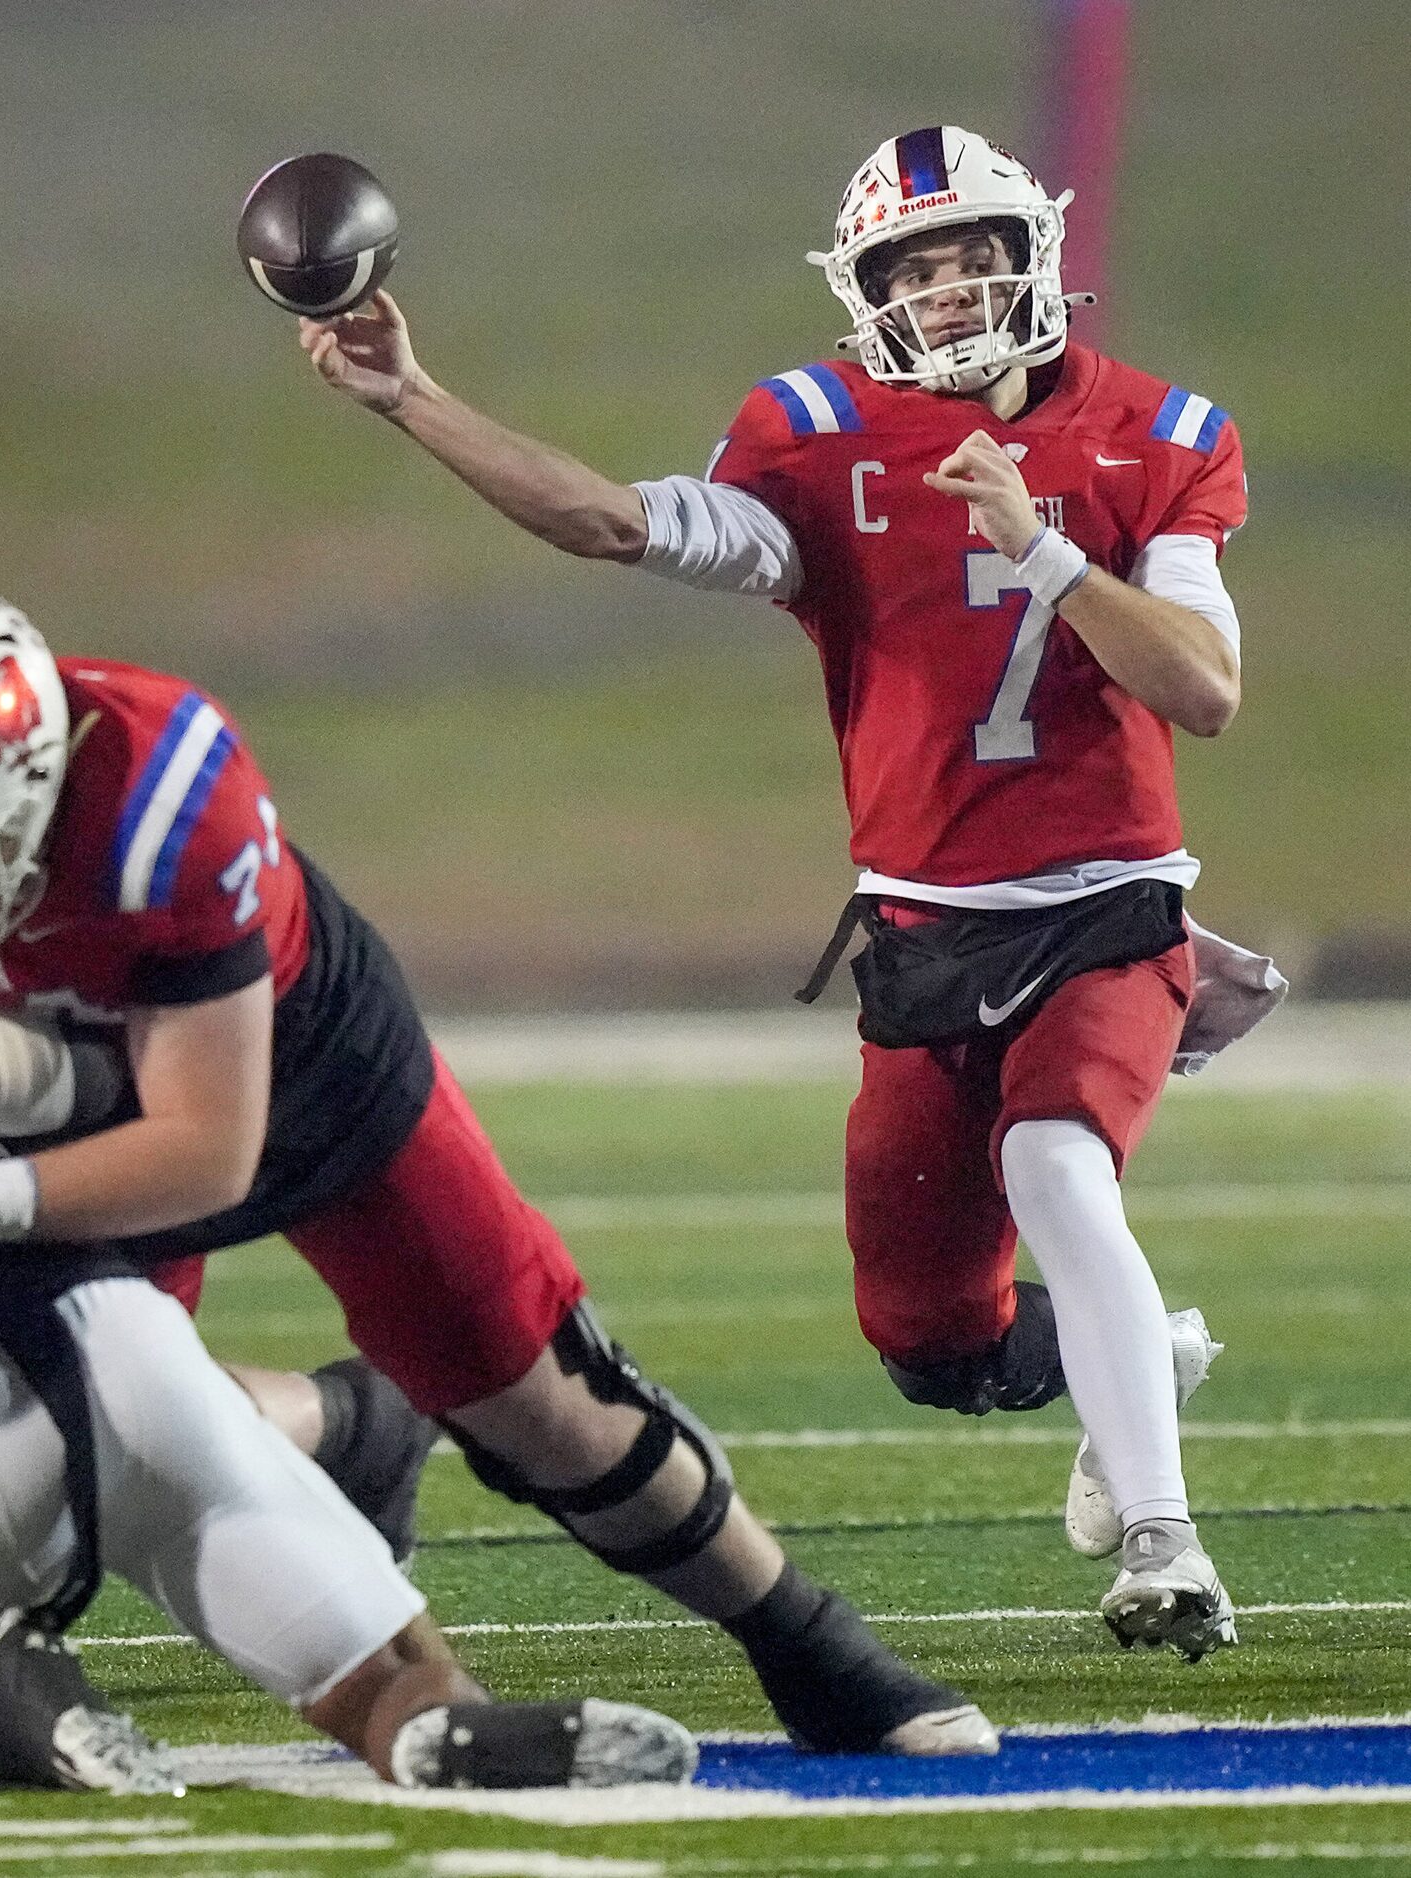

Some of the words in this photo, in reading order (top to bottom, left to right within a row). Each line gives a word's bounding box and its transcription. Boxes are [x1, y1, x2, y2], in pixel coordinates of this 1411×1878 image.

[898, 192, 959, 217] Riddell
[850, 459, 887, 534] C
[965, 550, 1056, 762] 7
